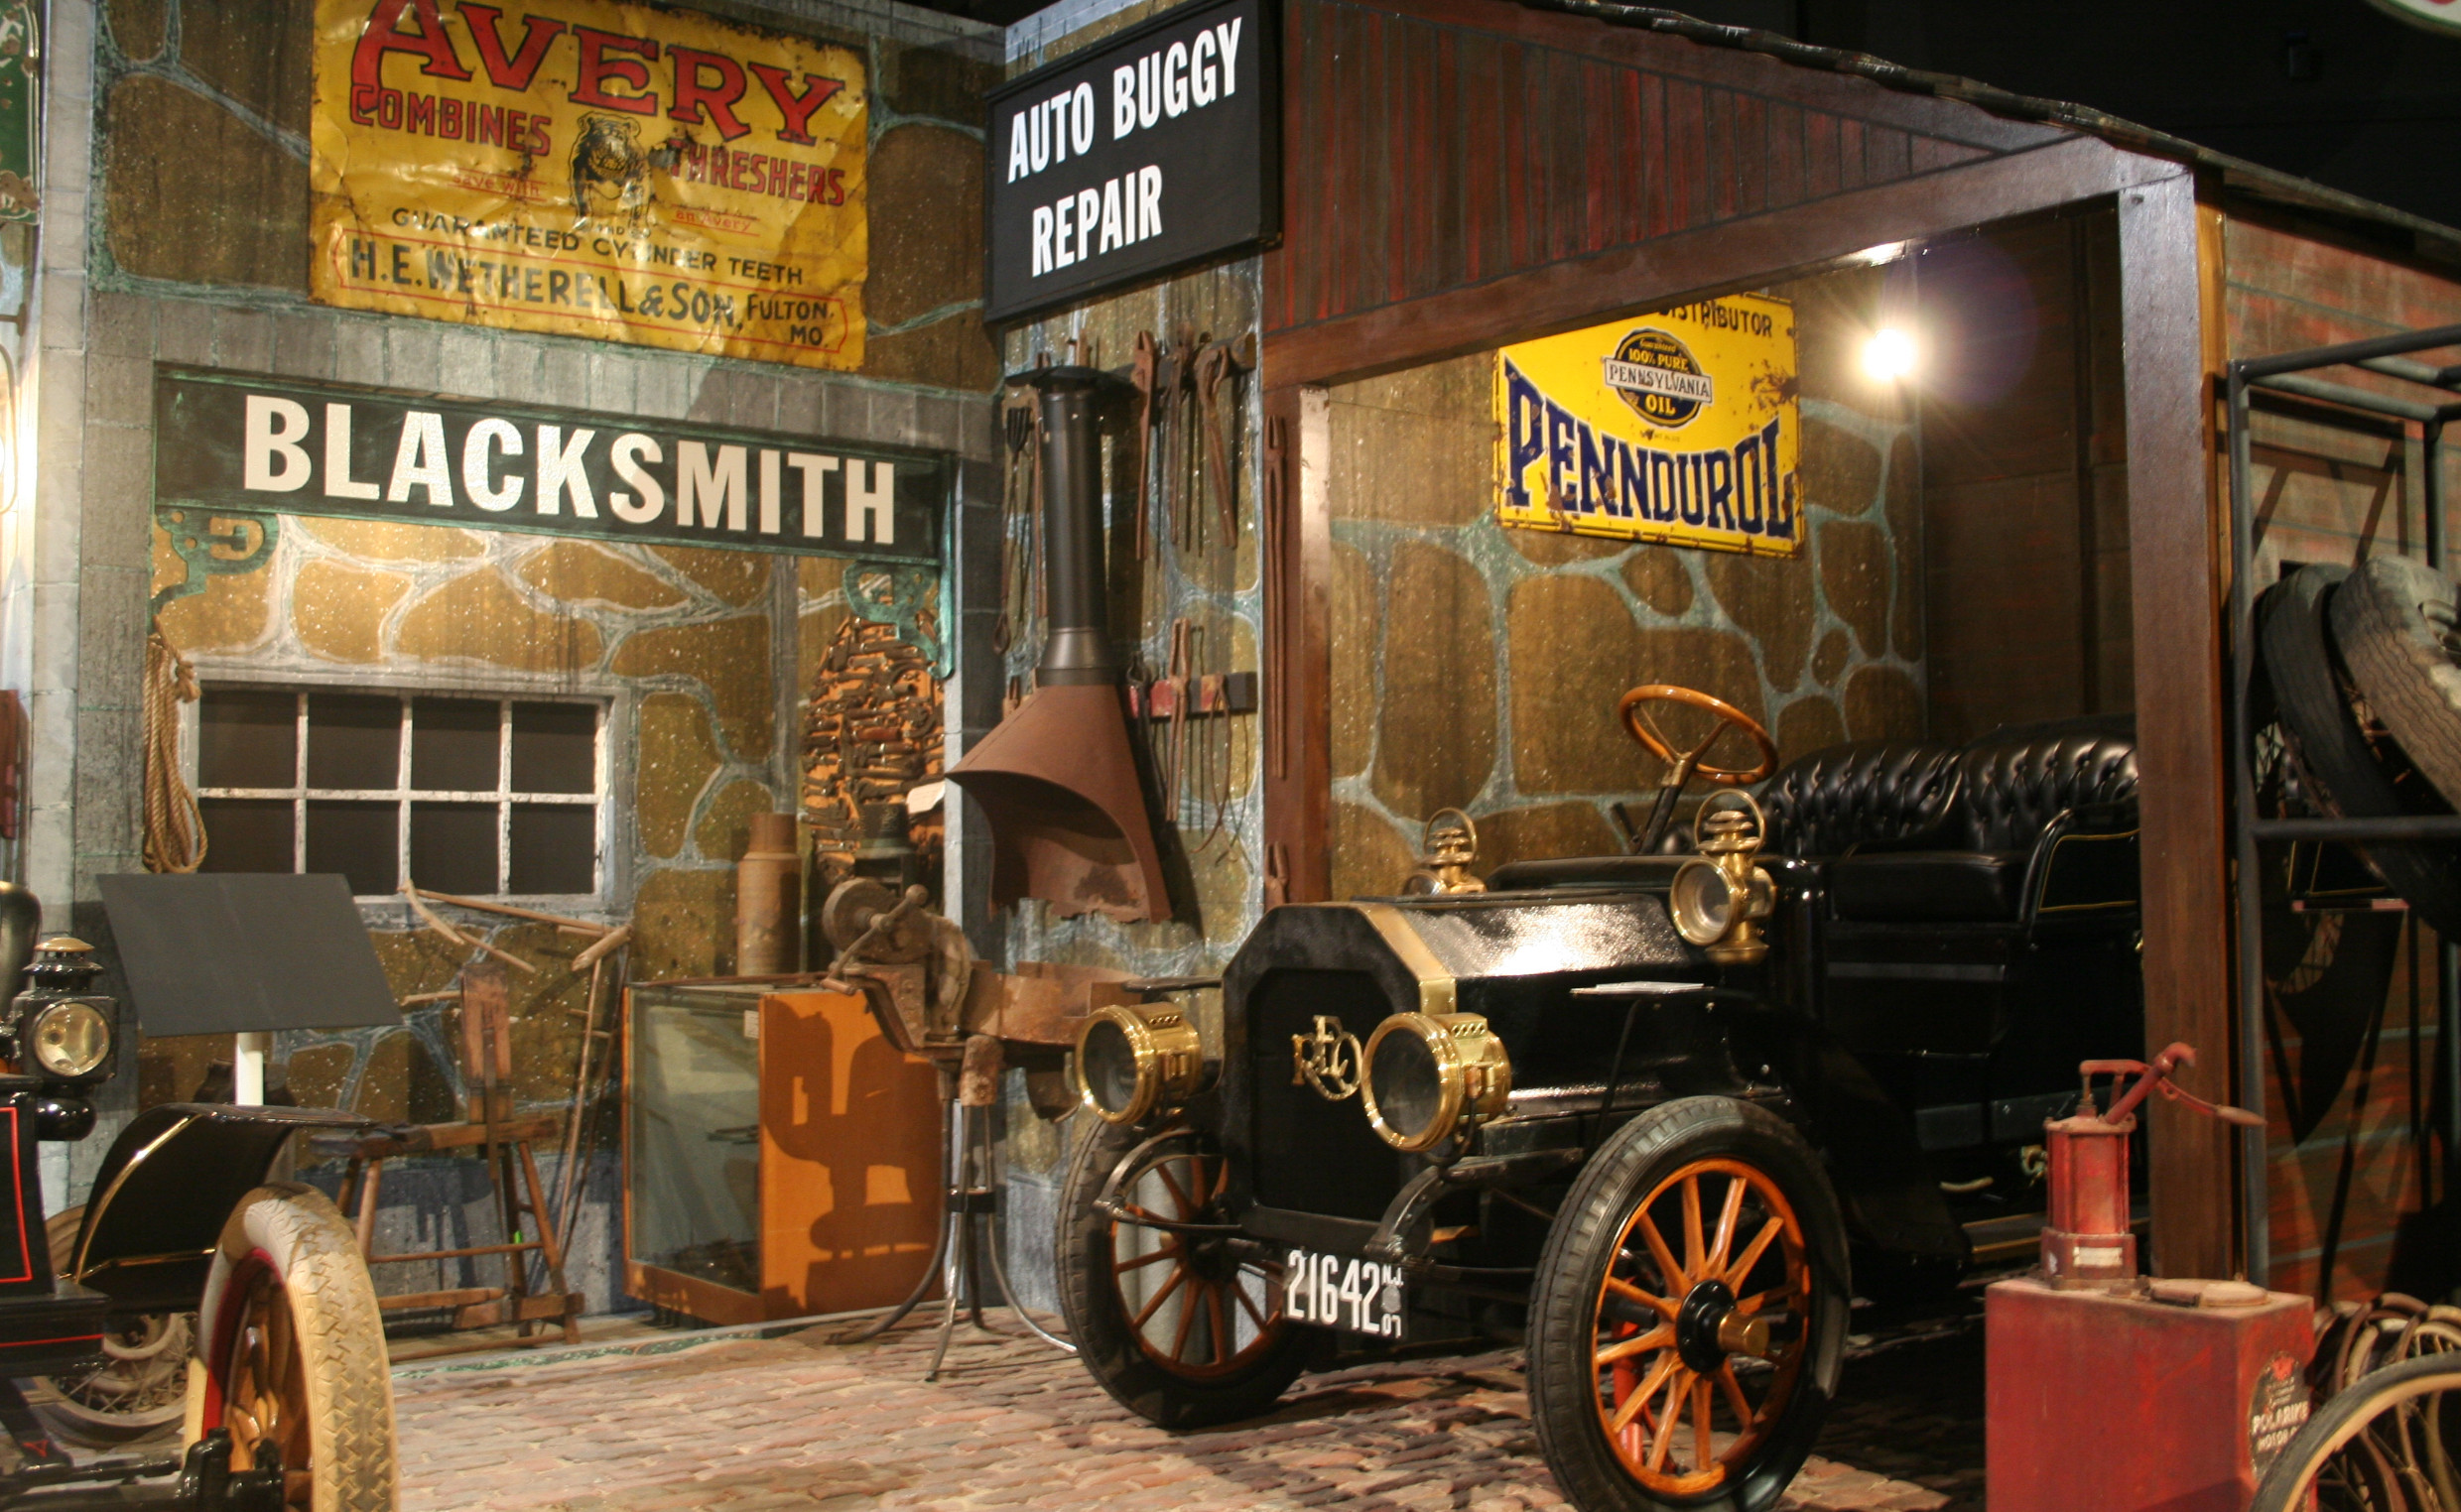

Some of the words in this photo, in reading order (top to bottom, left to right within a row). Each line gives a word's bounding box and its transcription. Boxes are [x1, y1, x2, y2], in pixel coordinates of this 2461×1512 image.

[350, 0, 845, 146] AVERY
[1007, 81, 1095, 185] AUTO
[1113, 16, 1242, 141] BUGGY
[349, 83, 552, 157] COMBINES
[667, 137, 845, 207] THRESHERS
[392, 207, 580, 252] GUARNTEED
[728, 257, 803, 286] TEETH
[676, 208, 695, 223] an
[700, 211, 753, 232] Avery
[1032, 164, 1163, 278] REPAIR
[1658, 300, 1772, 337] STRIBUTOR
[1609, 363, 1710, 397] PENNSYLVANIA
[1628, 348, 1657, 365] 100%
[1657, 353, 1688, 371] PURE
[1645, 393, 1676, 415] OIL
[243, 394, 896, 545] BLACKSMITH
[1503, 352, 1795, 539] PENNDUROL
[1288, 1249, 1380, 1334] 21642
